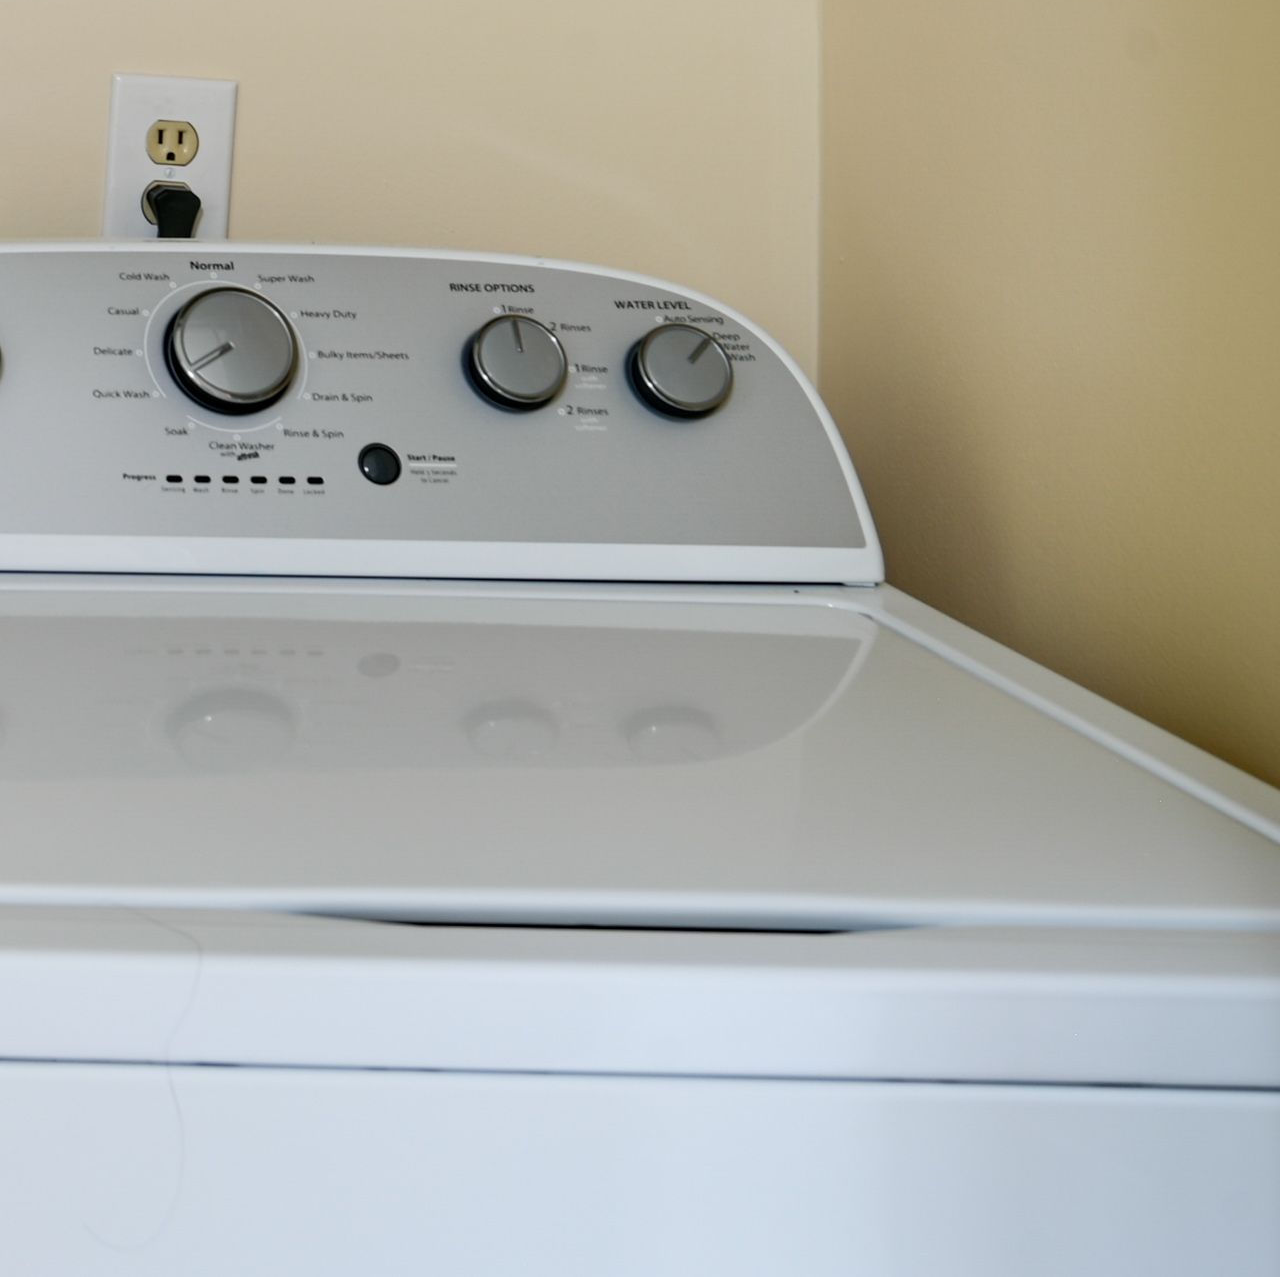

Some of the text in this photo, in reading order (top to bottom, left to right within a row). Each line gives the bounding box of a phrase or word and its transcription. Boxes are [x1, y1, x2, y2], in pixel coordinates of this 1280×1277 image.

[190, 260, 234, 272] Normal
[119, 272, 170, 281] Cold Wash
[258, 274, 315, 285] Super Wash
[449, 283, 535, 293] RINSE OPTIONS
[508, 306, 534, 314] Rinse
[614, 301, 691, 310] WATER LEVEL
[107, 307, 140, 316] Casual
[300, 310, 357, 320] Heavy Duty
[663, 315, 724, 325] Auto Sensing
[560, 323, 591, 332] Rinses
[713, 332, 740, 342] Deep
[93, 347, 133, 356] Delicate
[317, 350, 410, 362] Bulky Items/Sheets
[581, 365, 608, 373] Rinse
[92, 389, 150, 400] Quick Wash
[312, 392, 373, 404] Drain & Spin
[577, 407, 609, 416] Rinses
[164, 427, 188, 436] Soak
[283, 428, 344, 440] Rinse & Spin
[209, 441, 275, 451] Clean Washer
[407, 454, 426, 462] Start
[122, 473, 157, 482] Progress
